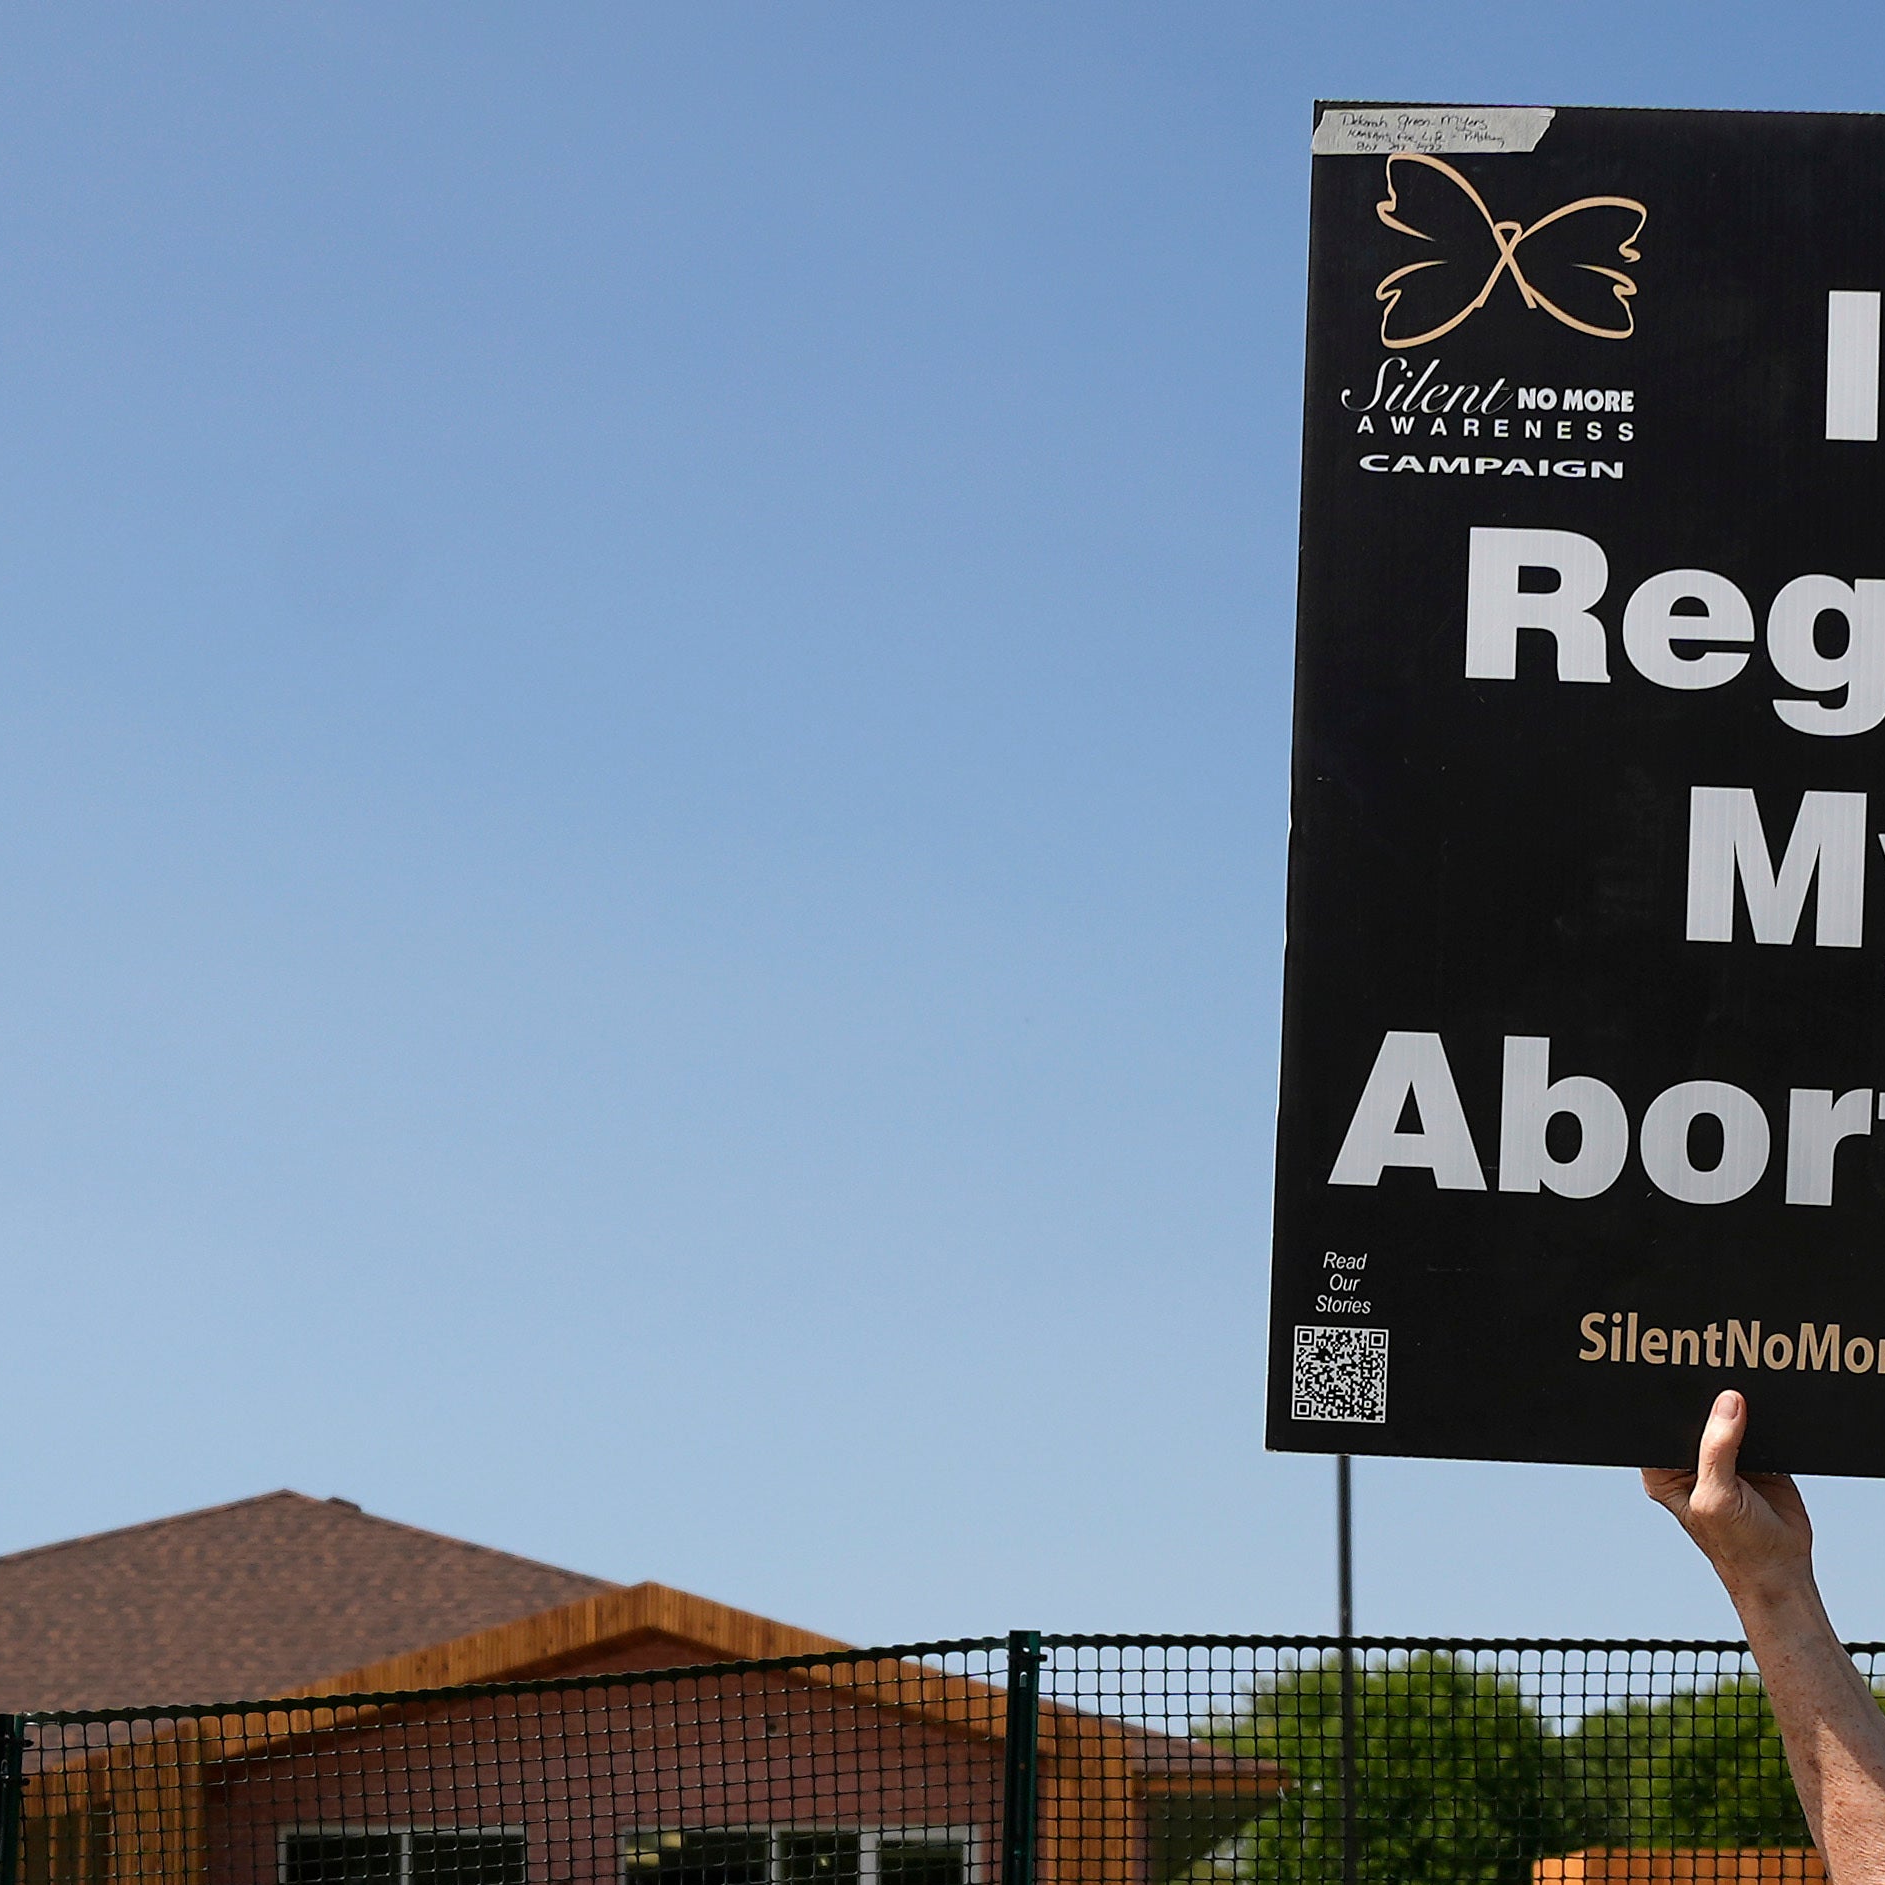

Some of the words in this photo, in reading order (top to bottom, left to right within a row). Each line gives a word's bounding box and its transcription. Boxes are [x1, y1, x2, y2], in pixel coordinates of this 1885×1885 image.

[1826, 291, 1881, 441] I
[1341, 356, 1514, 415] Silent
[1517, 387, 1558, 411] NO
[1562, 388, 1635, 413] MORE
[1357, 415, 1634, 442] AWARENESS
[1359, 454, 1624, 479] CAMPAIGN
[1323, 1251, 1368, 1270] Read
[1329, 1273, 1361, 1292] Our
[1315, 1294, 1372, 1314] Stories
